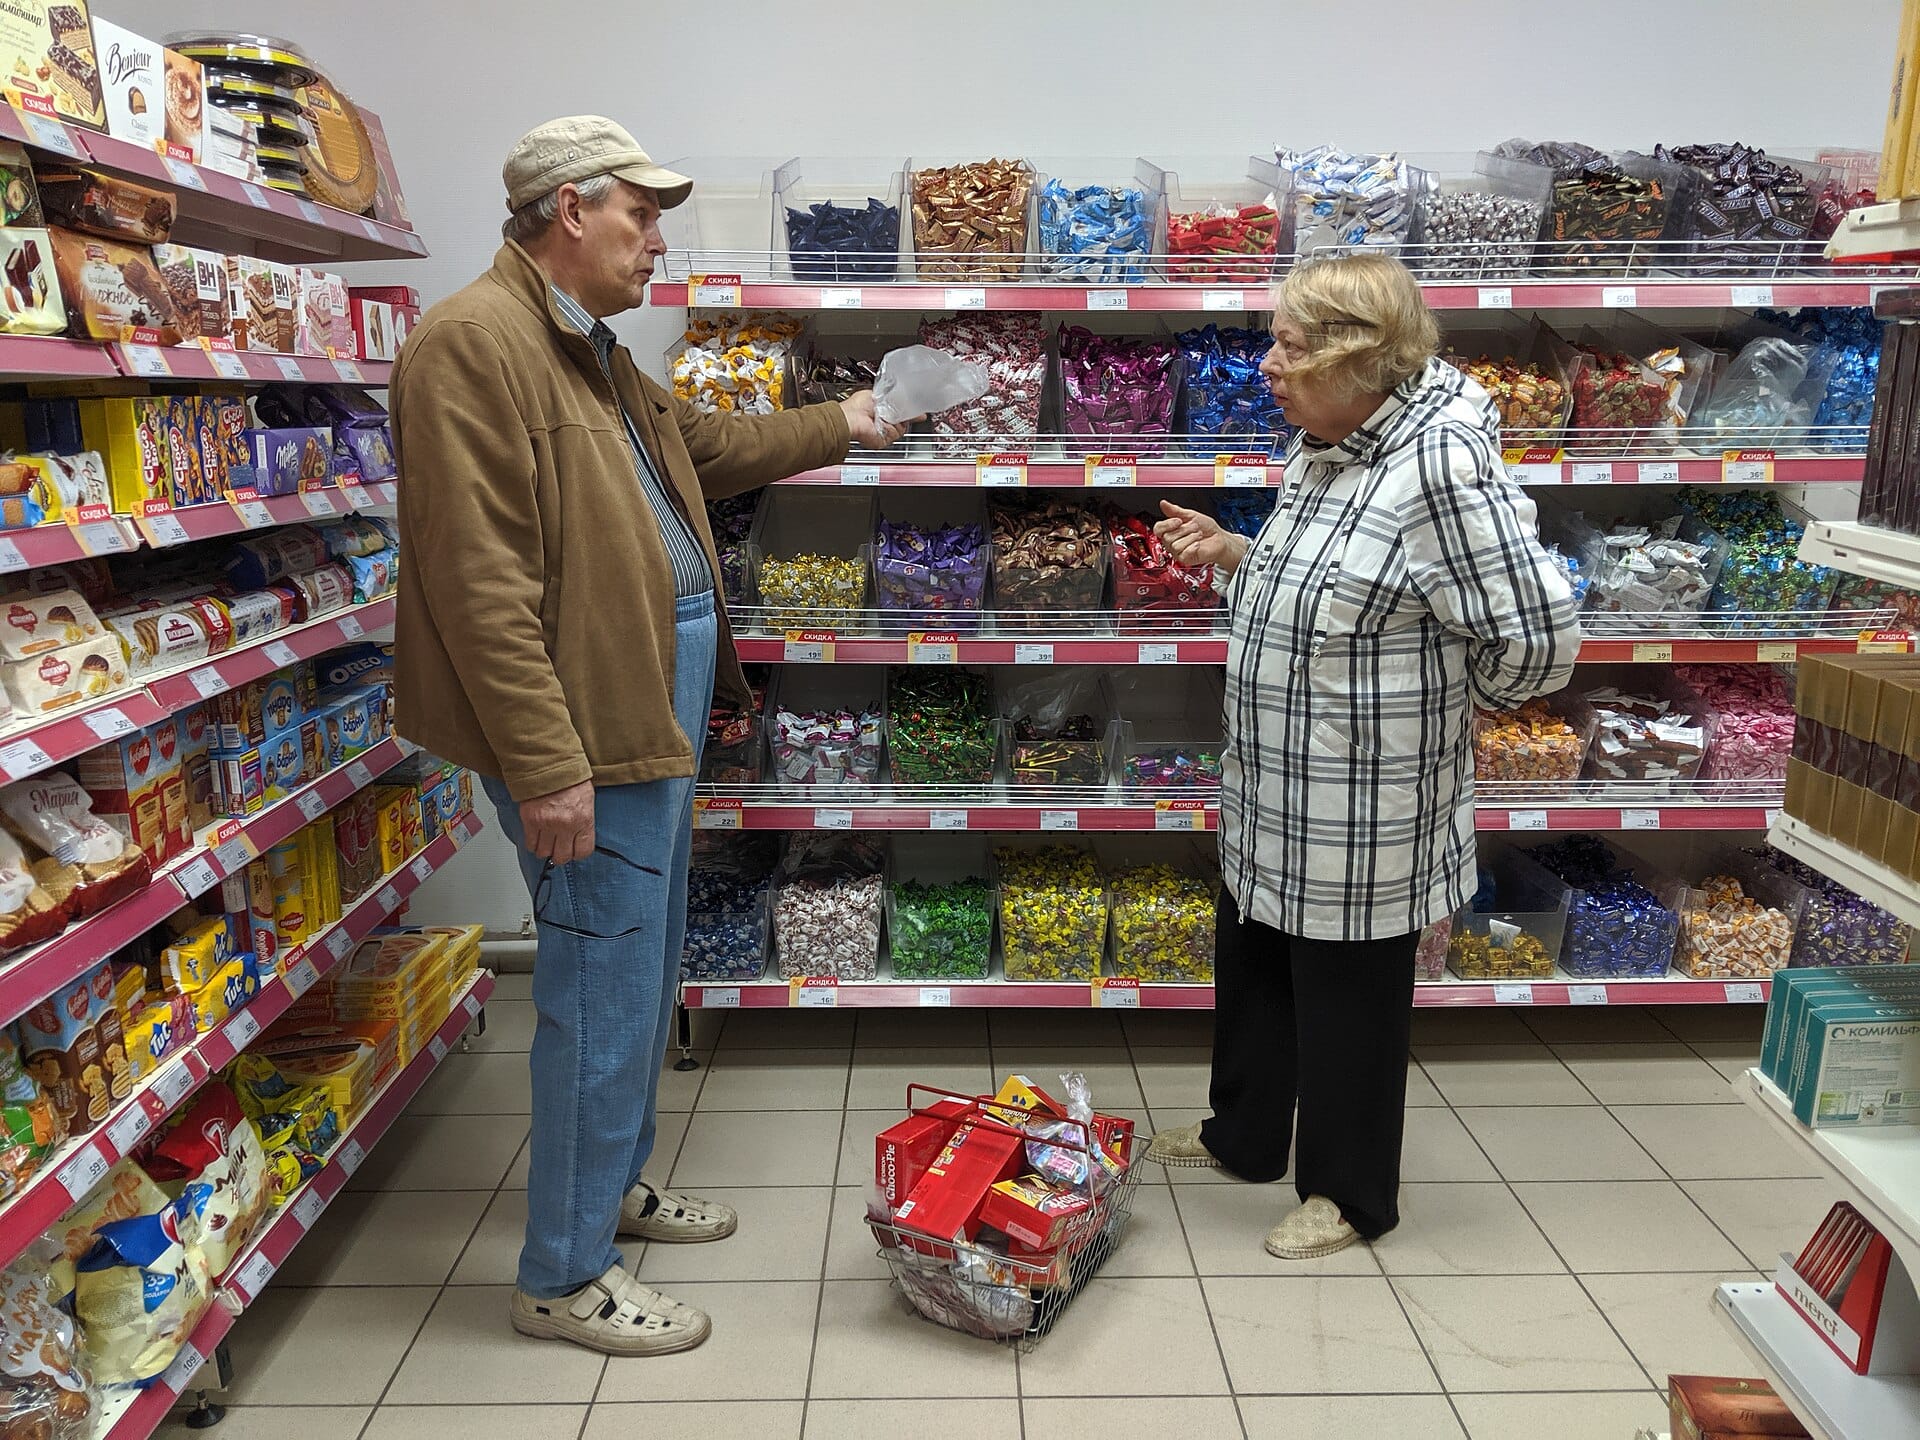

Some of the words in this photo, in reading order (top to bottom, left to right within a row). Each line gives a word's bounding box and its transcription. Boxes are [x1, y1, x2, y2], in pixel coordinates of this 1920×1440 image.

[105, 43, 152, 85] Bonjour
[24, 97, 53, 113] СКИДКА
[168, 147, 190, 160] СКИДКА
[708, 277, 738, 285] СКИДКА
[135, 331, 158, 343] СКИДКА
[276, 440, 299, 471] Milka
[237, 491, 257, 499] СКИДКА
[80, 509, 109, 520] СКИДКА
[146, 502, 170, 513] СКИДКА
[1876, 633, 1906, 641] СКИДКА
[329, 656, 382, 684] OREO
[115, 719, 128, 732] 50
[343, 712, 365, 734] Барни
[276, 751, 298, 769] Барни
[30, 787, 80, 816] Мария
[219, 823, 240, 839] СКИДКА
[201, 872, 212, 884] 69
[287, 950, 304, 966] СКИДКА
[807, 978, 835, 986] СКИДКА
[1108, 979, 1137, 987] СКИДКА
[223, 975, 243, 1009] TUC
[151, 1019, 173, 1058] TUC
[88, 1162, 101, 1176] 59
[215, 1143, 247, 1193] МИНИ
[885, 1143, 896, 1200] Choco-Pie
[257, 1262, 269, 1278] 109
[1794, 1286, 1839, 1337] merci
[183, 1355, 197, 1372] 109
